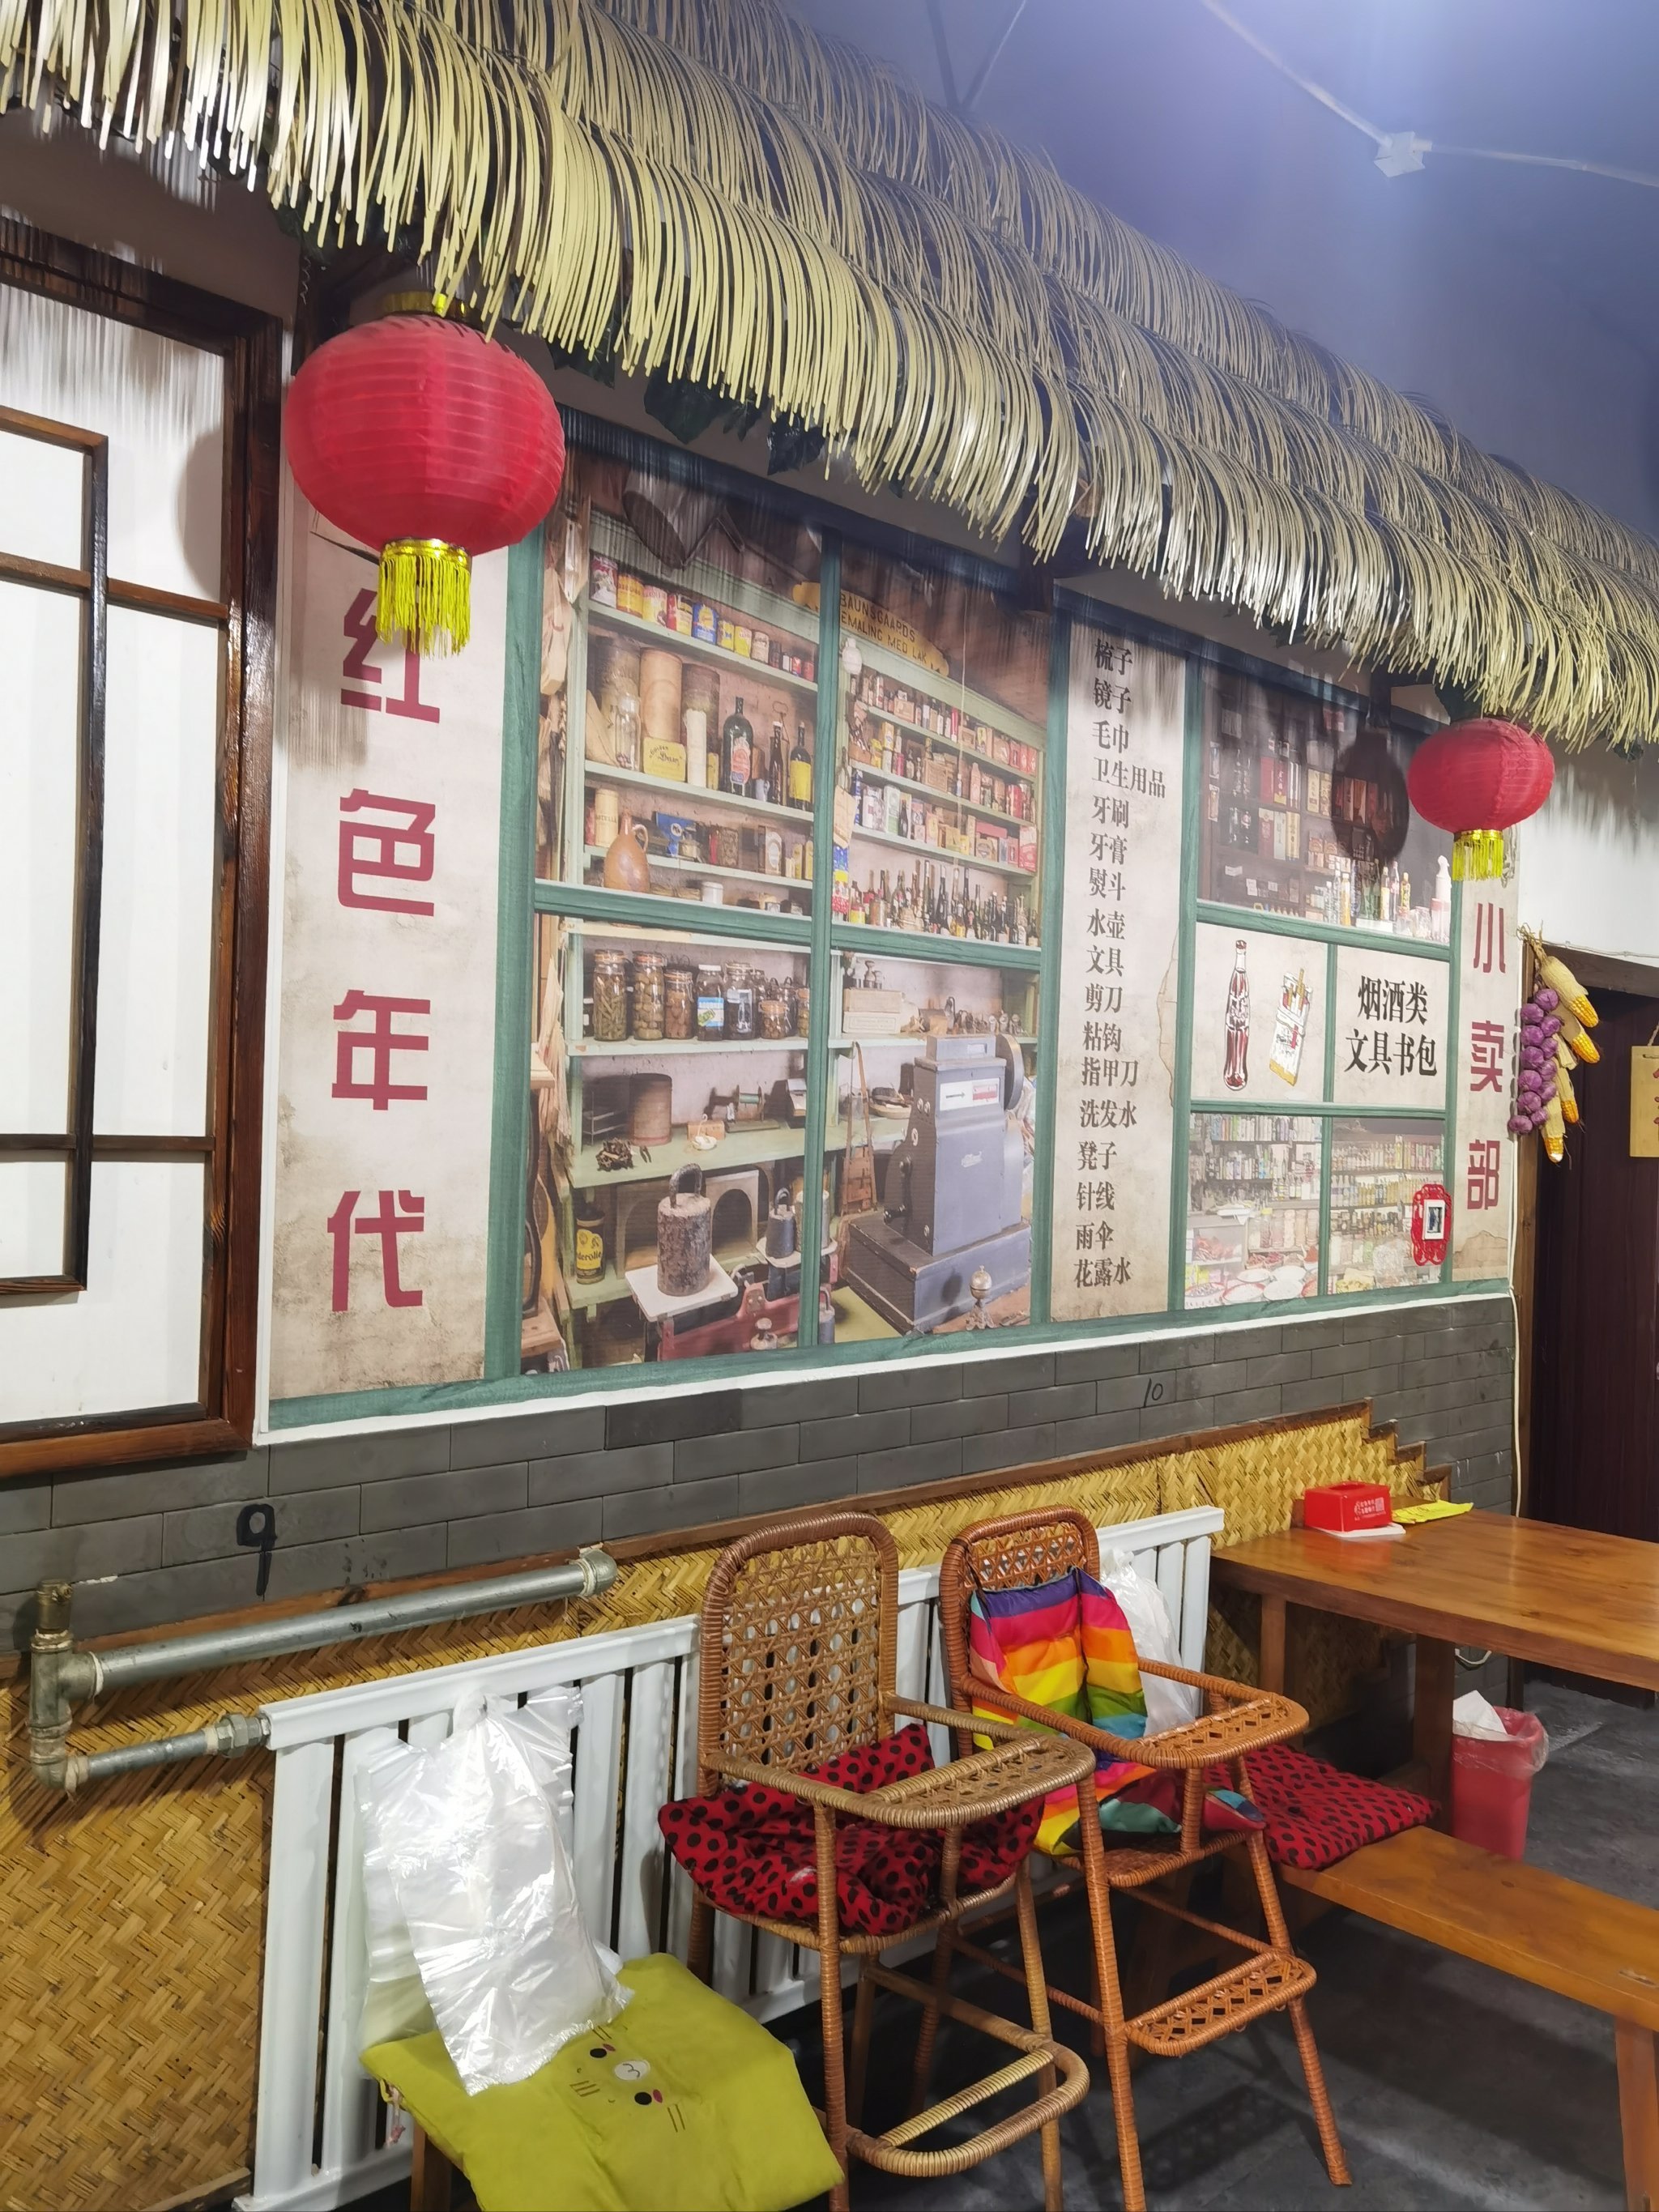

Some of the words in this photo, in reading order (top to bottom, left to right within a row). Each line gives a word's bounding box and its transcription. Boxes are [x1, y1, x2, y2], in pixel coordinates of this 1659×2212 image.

[1094, 638, 1133, 676] 梳子
[1094, 677, 1132, 714] 镜子
[1092, 720, 1129, 754] 毛巾
[1092, 757, 1166, 799] 卫生用品
[1092, 795, 1129, 829] 牙刷
[1089, 832, 1128, 865] 牙膏
[1089, 867, 1126, 901] 熨斗
[1086, 908, 1125, 940] 水壶
[326, 588, 441, 1311] 红色年代
[1085, 944, 1124, 977] 文具
[1084, 983, 1123, 1013] 剪刀
[1357, 975, 1429, 1025] 烟酒类
[1082, 1021, 1121, 1053] 粘钩
[1343, 1029, 1438, 1077] 文具书包
[1081, 1056, 1139, 1087] 指甲刀
[1467, 902, 1507, 1210] 小卖部
[1080, 1099, 1137, 1129] 洗发水
[1077, 1140, 1117, 1172] 凳子
[1076, 1182, 1115, 1212] 针线
[1076, 1221, 1114, 1251] 雨伞
[1073, 1257, 1132, 1289] 花露水
[1143, 1378, 1163, 1408] 10
[237, 1504, 278, 1601] 9
